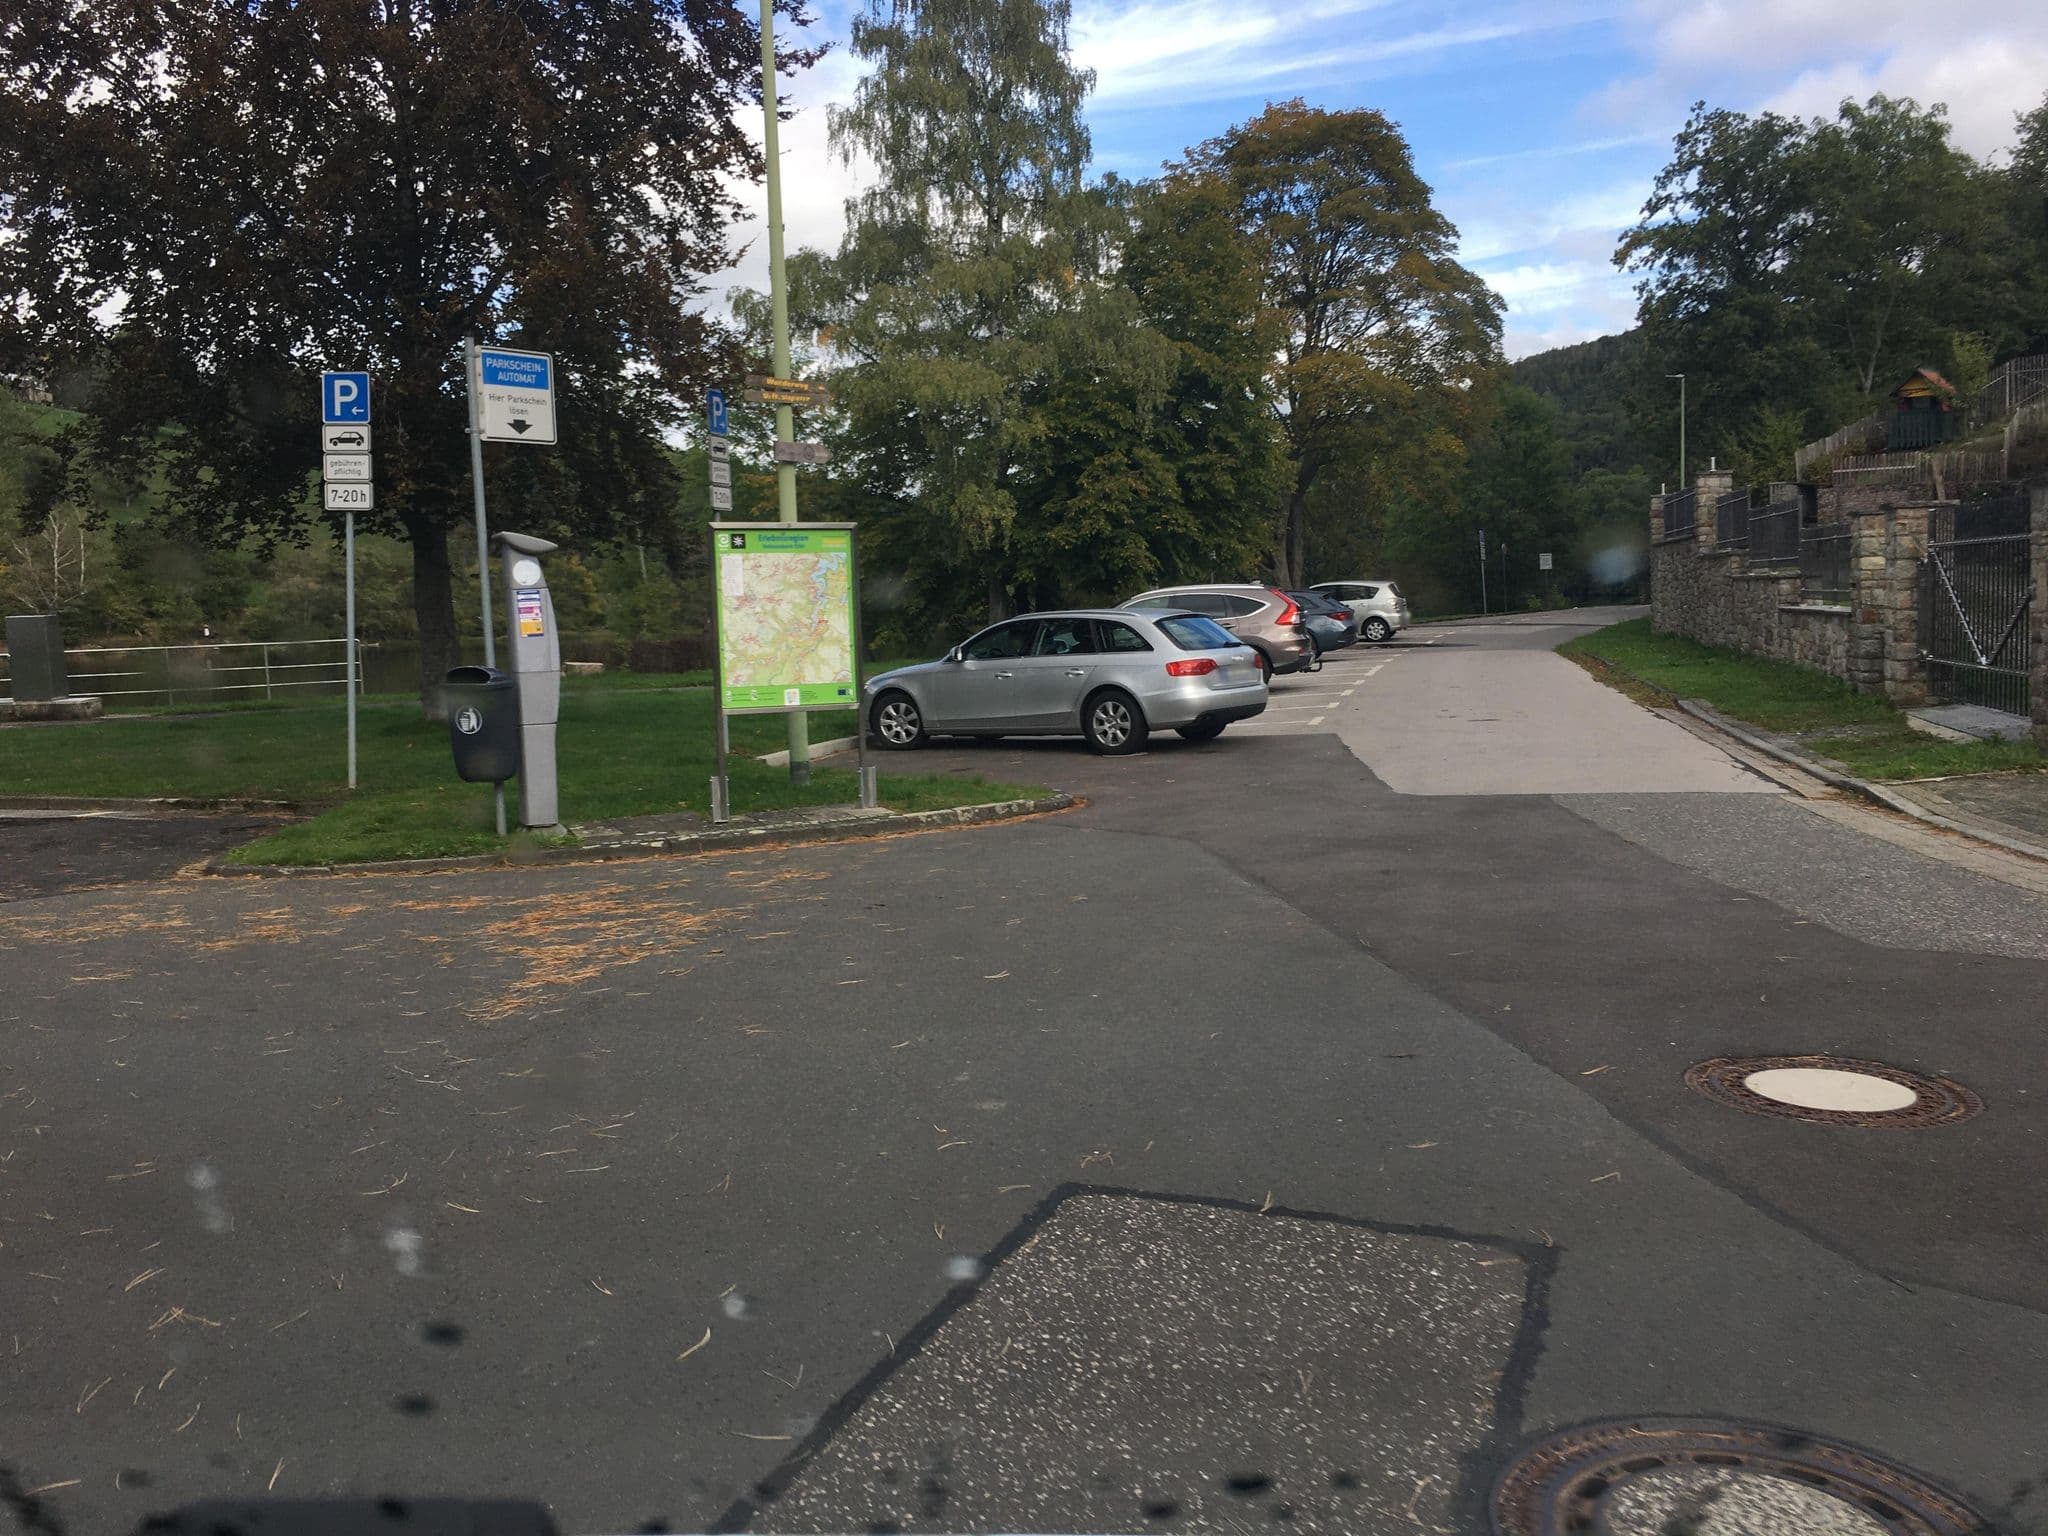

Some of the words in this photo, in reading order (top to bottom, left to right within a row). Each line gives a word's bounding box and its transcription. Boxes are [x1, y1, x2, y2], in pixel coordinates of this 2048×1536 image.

[486, 358, 545, 377] PARKSCHEIN-
[497, 372, 536, 385] AUTOMAT
[334, 380, 358, 416] P
[488, 392, 505, 403] Hier
[507, 394, 547, 406] Parkschein
[509, 406, 529, 416] lösen
[712, 396, 722, 427] P
[329, 458, 366, 470] gebühren-
[333, 467, 361, 477] pflichtig
[331, 490, 358, 503] 7-20
[360, 490, 366, 503] h
